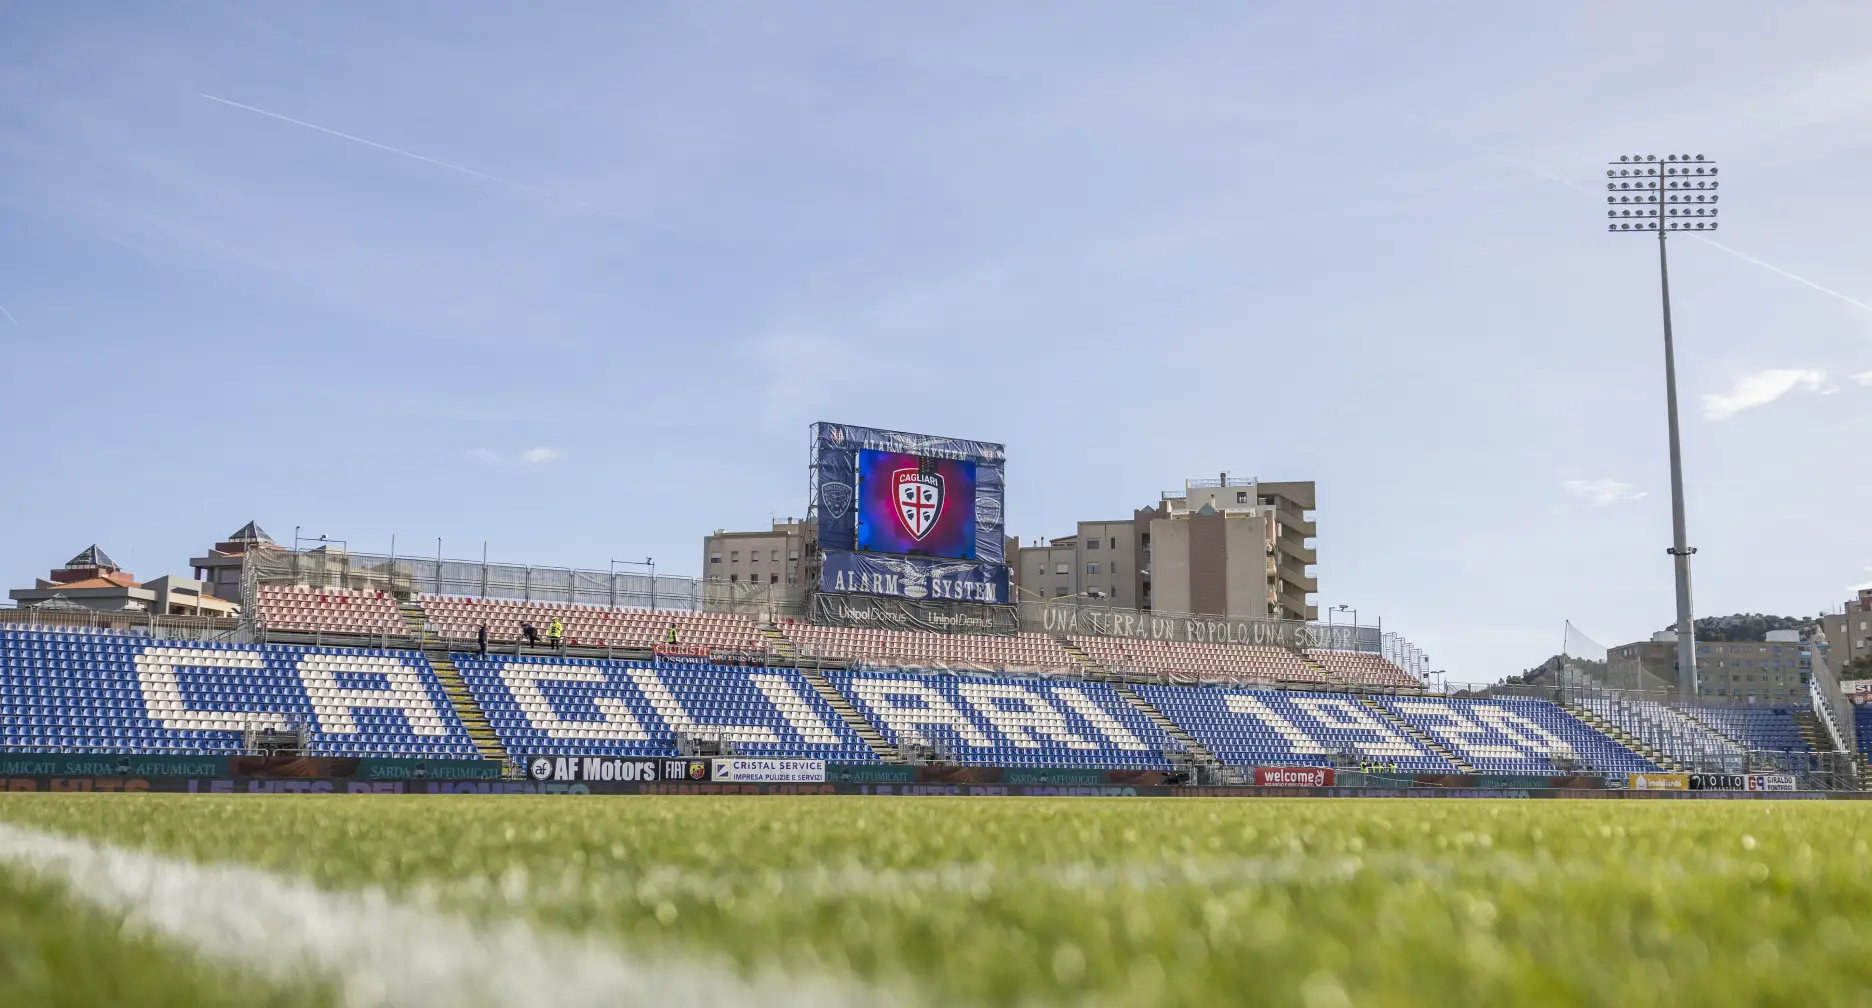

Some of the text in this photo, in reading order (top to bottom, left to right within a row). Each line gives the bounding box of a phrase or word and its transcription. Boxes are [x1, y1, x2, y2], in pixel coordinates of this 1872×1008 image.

[900, 473, 938, 487] CAGLIARI
[835, 570, 997, 601] ALARM SYSTEM
[928, 611, 993, 628] UnipolDomus
[1043, 608, 1078, 631] UNA
[1254, 623, 1286, 645] UNA
[65, 762, 112, 775] SARDA
[136, 762, 216, 775] AFFUMICATI
[370, 765, 411, 778] SARDA
[554, 757, 687, 781] AF Motors FIAT
[780, 761, 822, 770] SERVICE
[733, 773, 763, 781] IMPRESA
[765, 773, 791, 781] PULIZIE
[1264, 768, 1315, 782] welcome
[1767, 776, 1793, 784] GIRALDO
